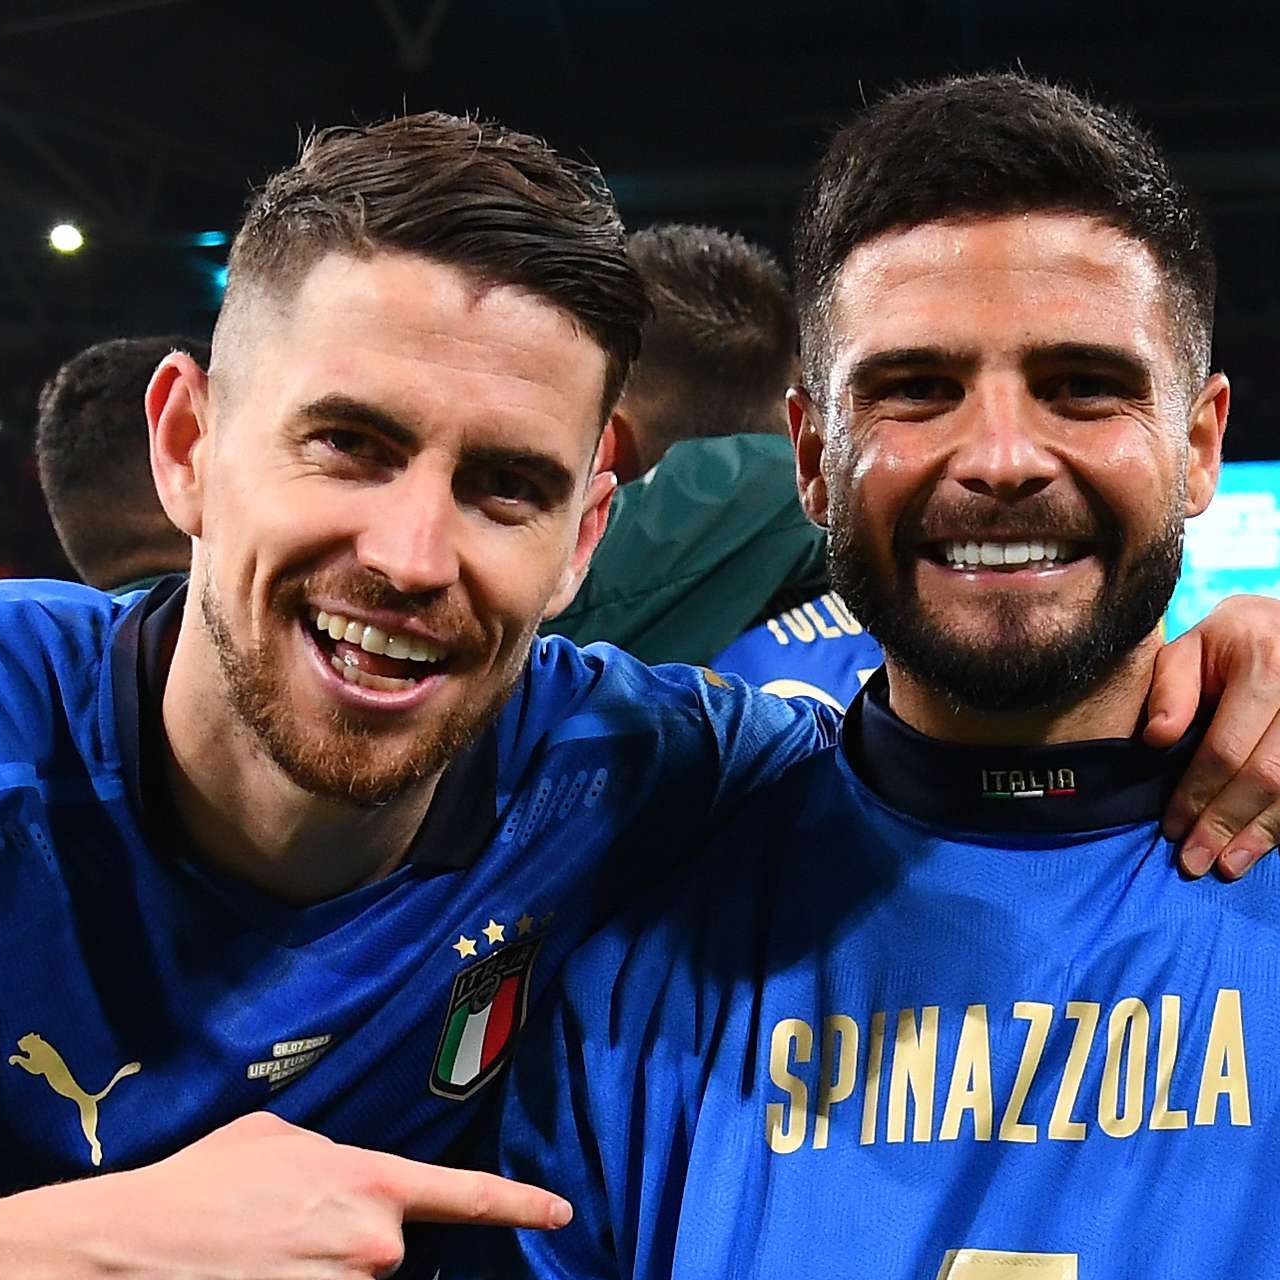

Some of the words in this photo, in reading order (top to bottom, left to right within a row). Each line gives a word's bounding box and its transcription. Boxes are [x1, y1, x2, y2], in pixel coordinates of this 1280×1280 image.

[981, 768, 1075, 791] ITALIA
[249, 1060, 281, 1077] UEFA
[765, 988, 1252, 1154] SPINAZZOLA
